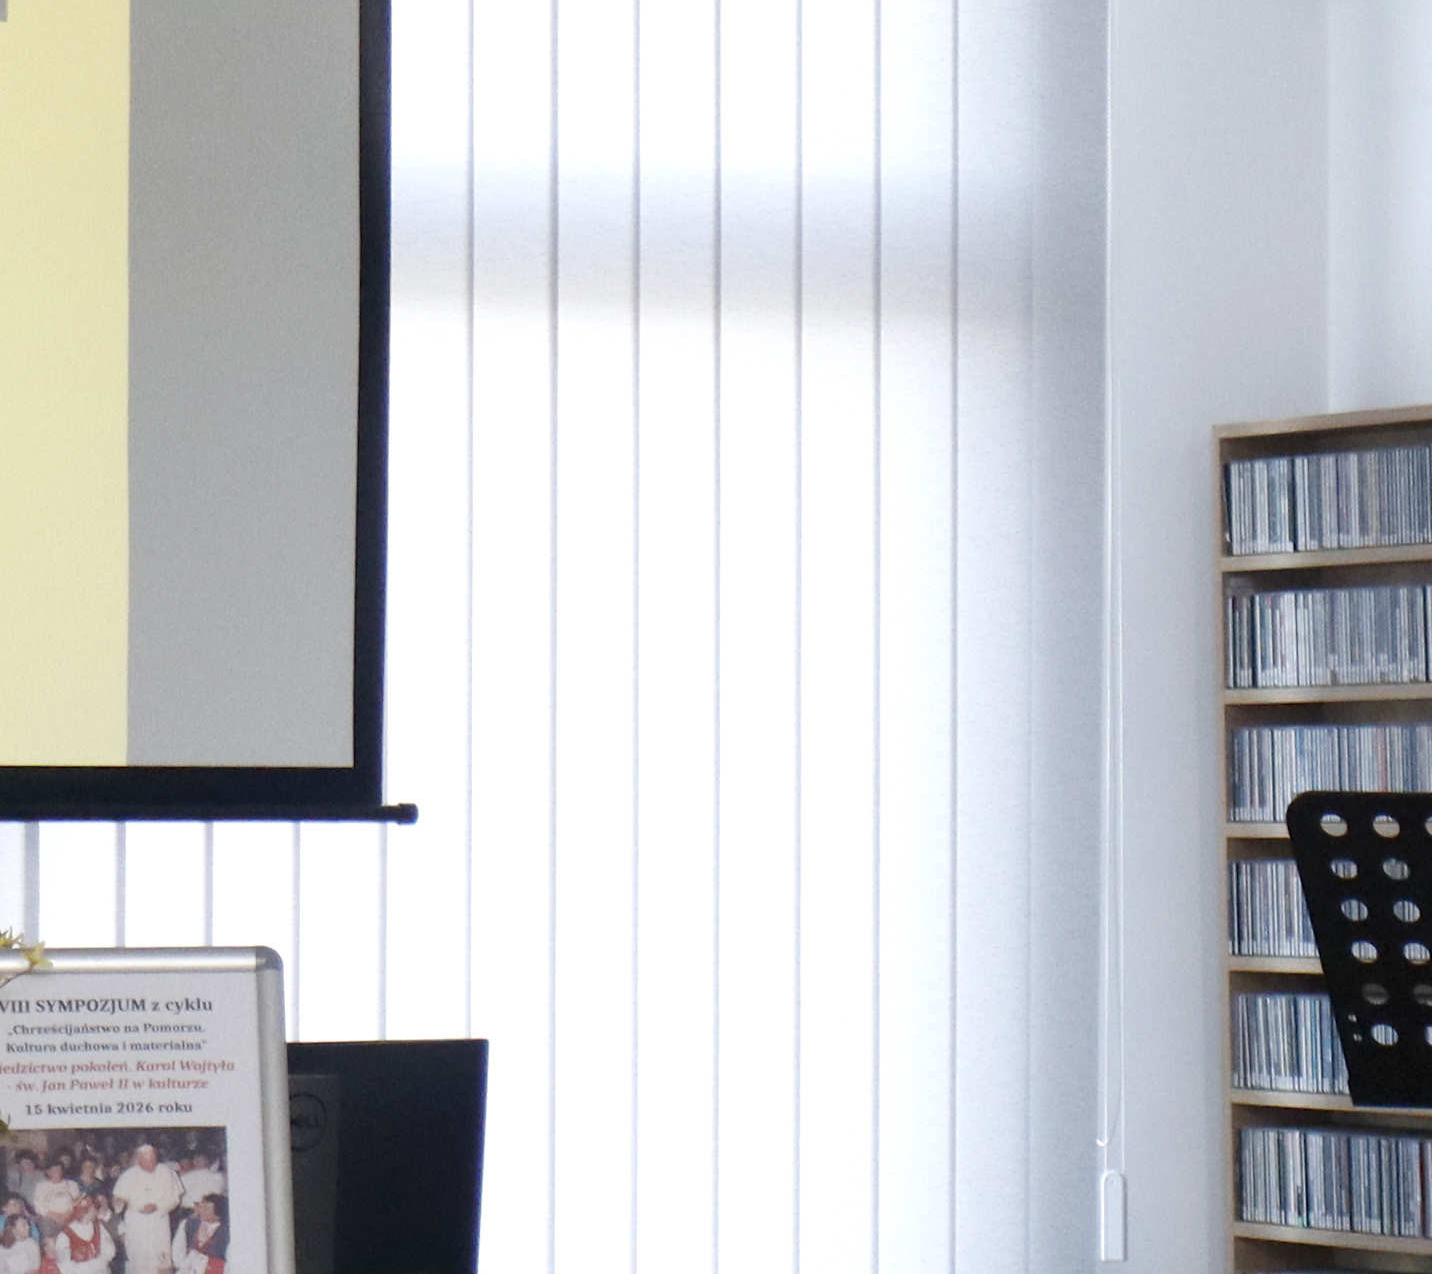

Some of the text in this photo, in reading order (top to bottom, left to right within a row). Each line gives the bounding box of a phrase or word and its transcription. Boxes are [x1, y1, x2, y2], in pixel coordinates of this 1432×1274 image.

[35, 998, 147, 1016] SYMPOZJUM
[151, 1001, 160, 1012] z
[165, 997, 213, 1015] cyklu
[124, 1024, 139, 1033] na
[6, 1041, 58, 1054] Kultura
[59, 1040, 119, 1053] duchowa
[135, 1060, 176, 1073] Karol
[179, 1060, 236, 1075] Wojtyła
[41, 1079, 67, 1094] Jan
[69, 1078, 114, 1091] Paweł
[117, 1079, 128, 1090] II
[131, 1081, 143, 1090] w
[148, 1077, 209, 1090] kulturze
[25, 1100, 194, 1117] 15 kwietnia 2026 roku
